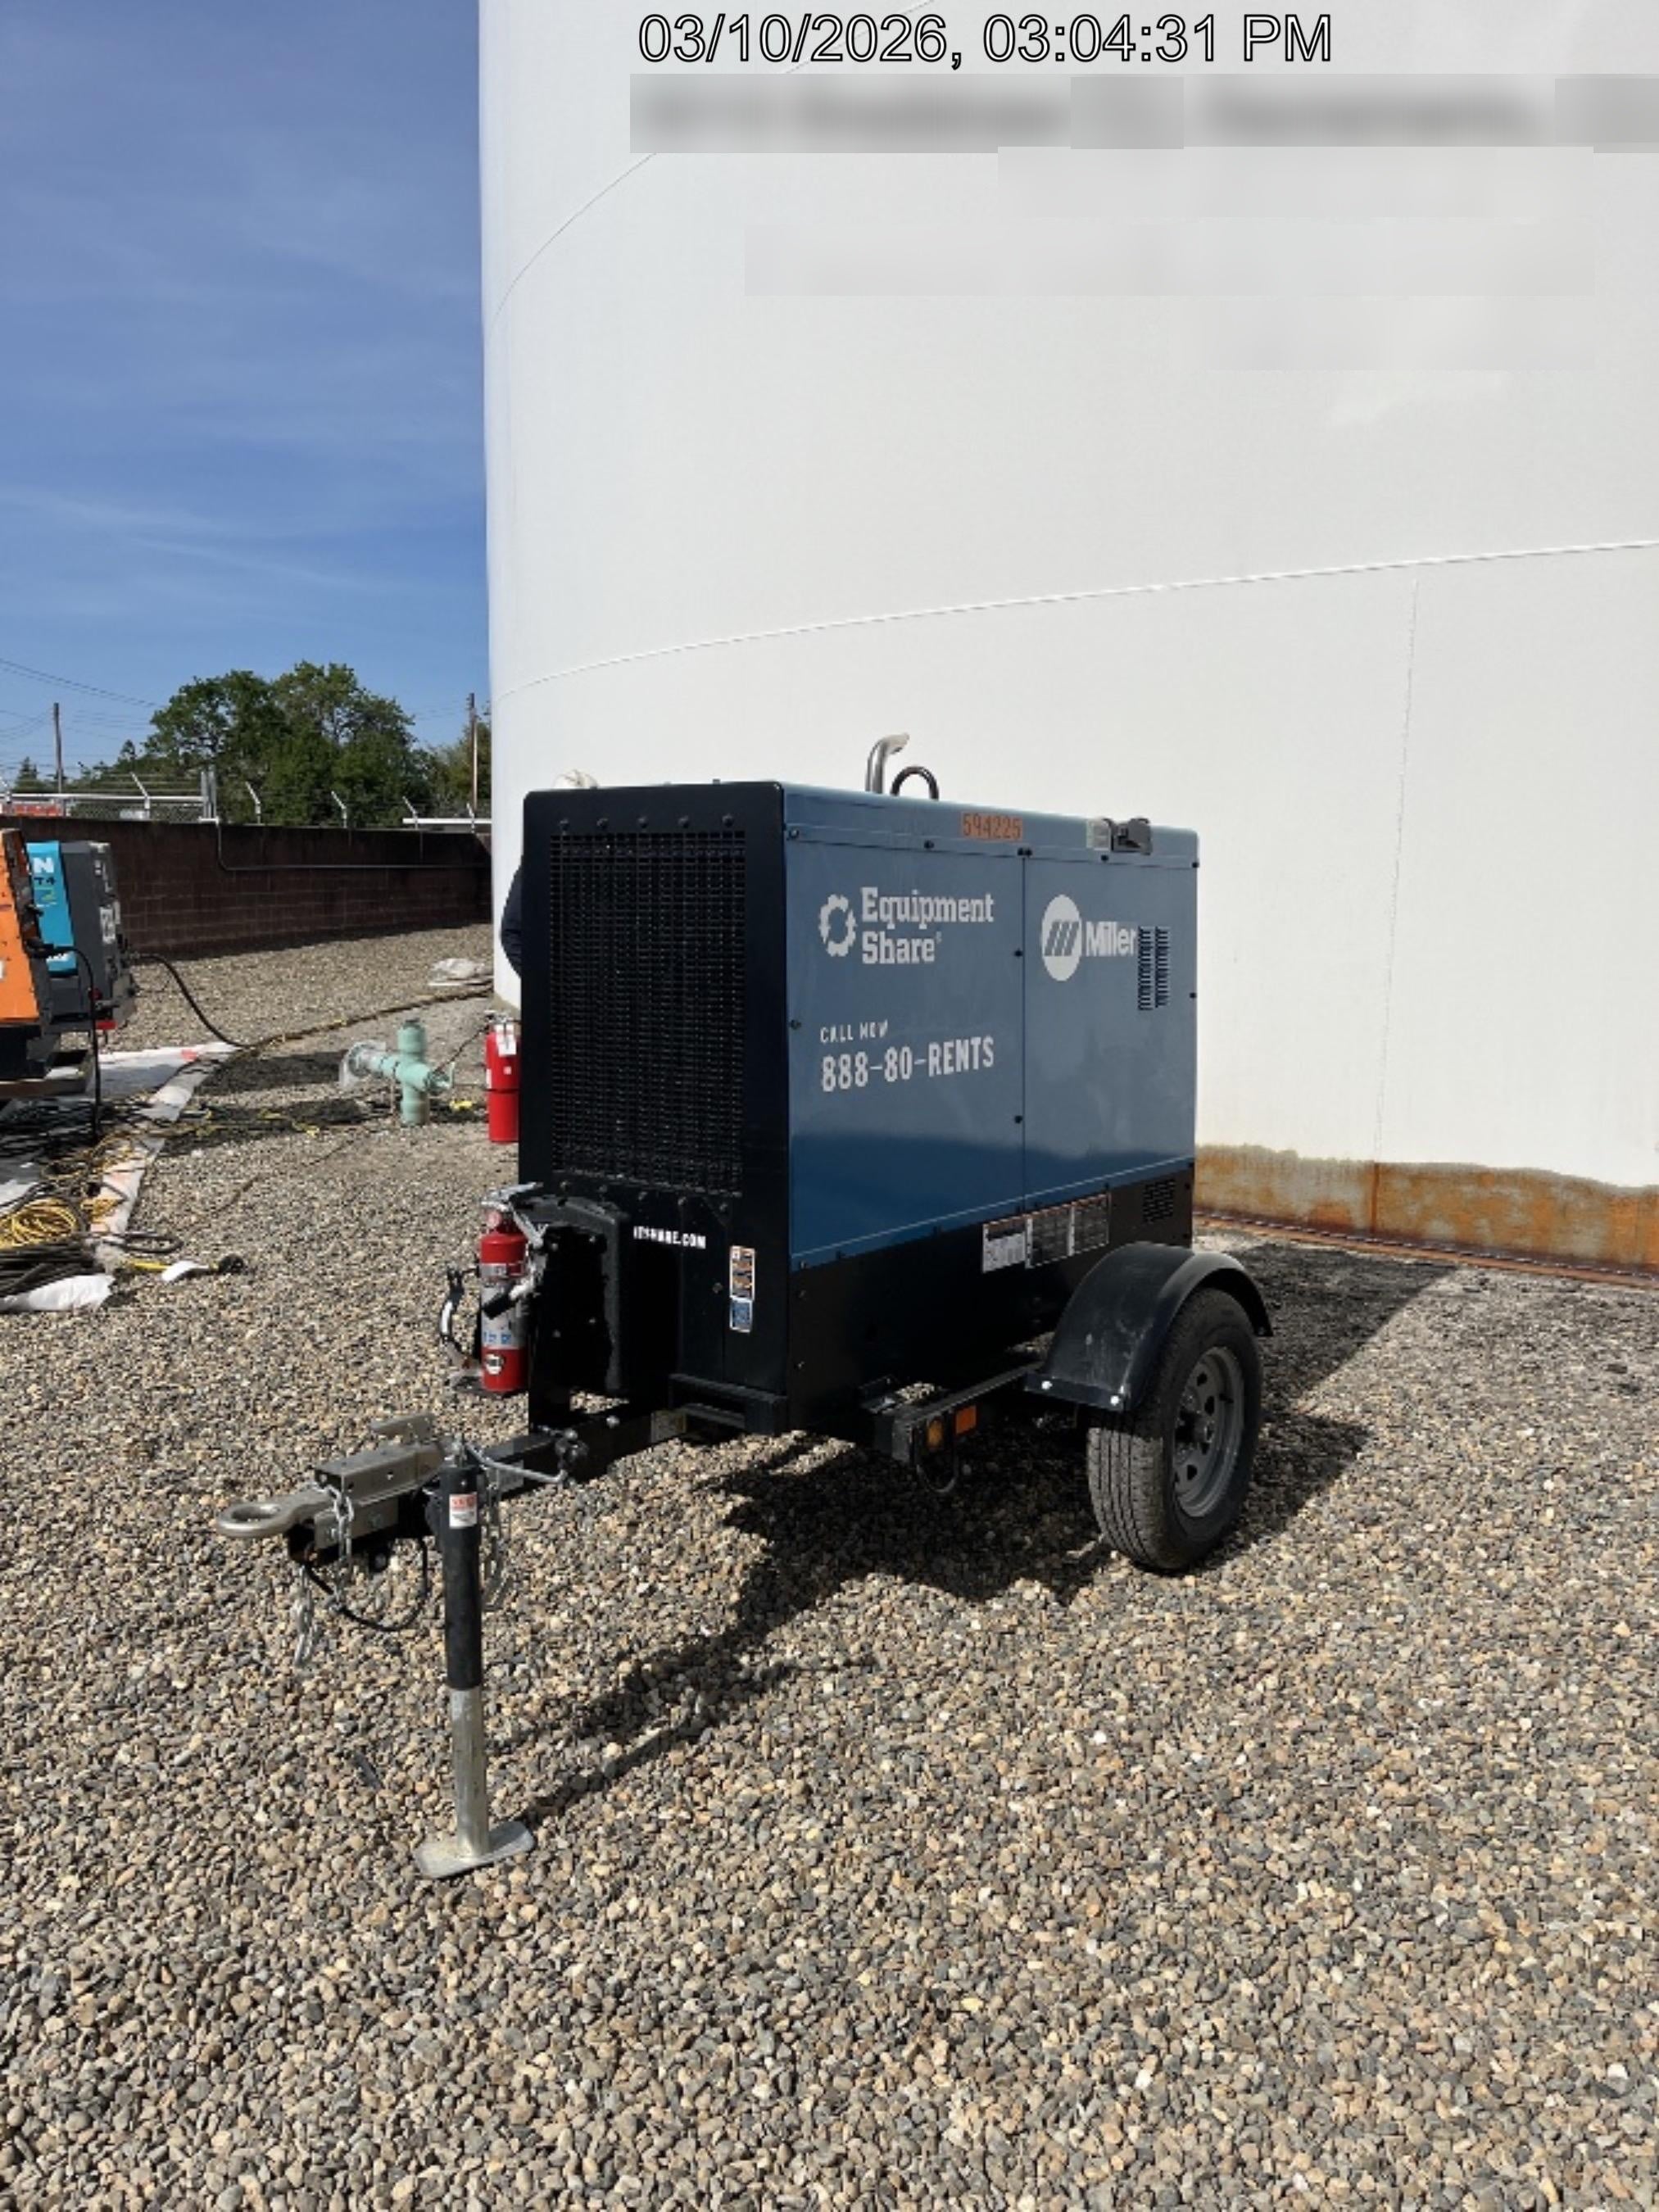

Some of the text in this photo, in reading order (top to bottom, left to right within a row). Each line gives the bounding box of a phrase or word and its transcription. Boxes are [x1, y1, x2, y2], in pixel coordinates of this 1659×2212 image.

[963, 813, 1022, 841] 594225
[861, 886, 995, 929] Equipment
[1086, 921, 1137, 958] Miller
[820, 1018, 889, 1045] CALL NOW
[822, 1034, 995, 1092] 888-80-RENTS
